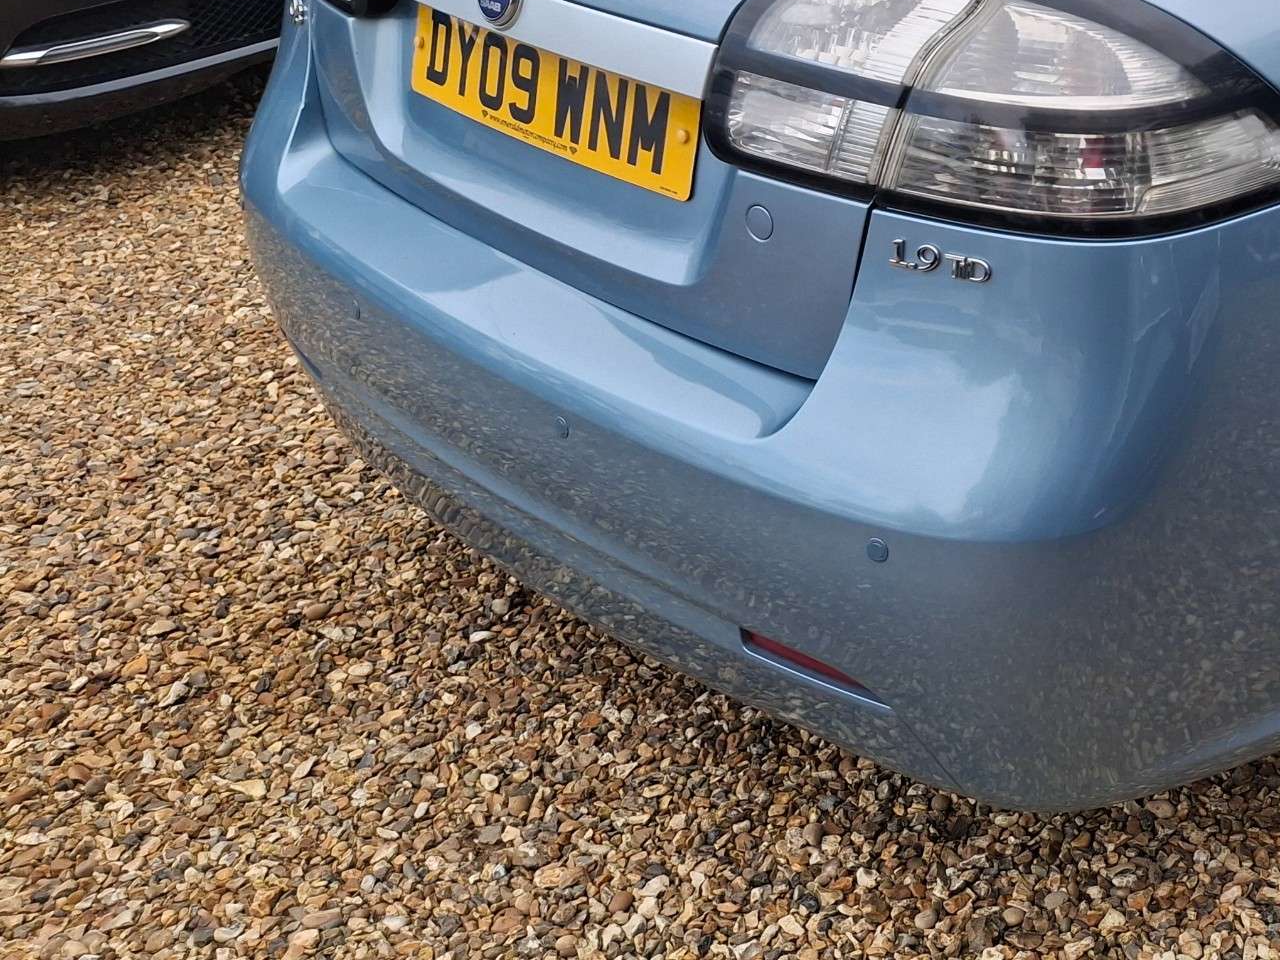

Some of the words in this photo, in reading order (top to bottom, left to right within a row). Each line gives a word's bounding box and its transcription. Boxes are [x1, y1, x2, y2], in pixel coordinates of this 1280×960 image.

[426, 8, 541, 126] DY09
[554, 57, 671, 176] WNM
[888, 238, 942, 272] 1.9
